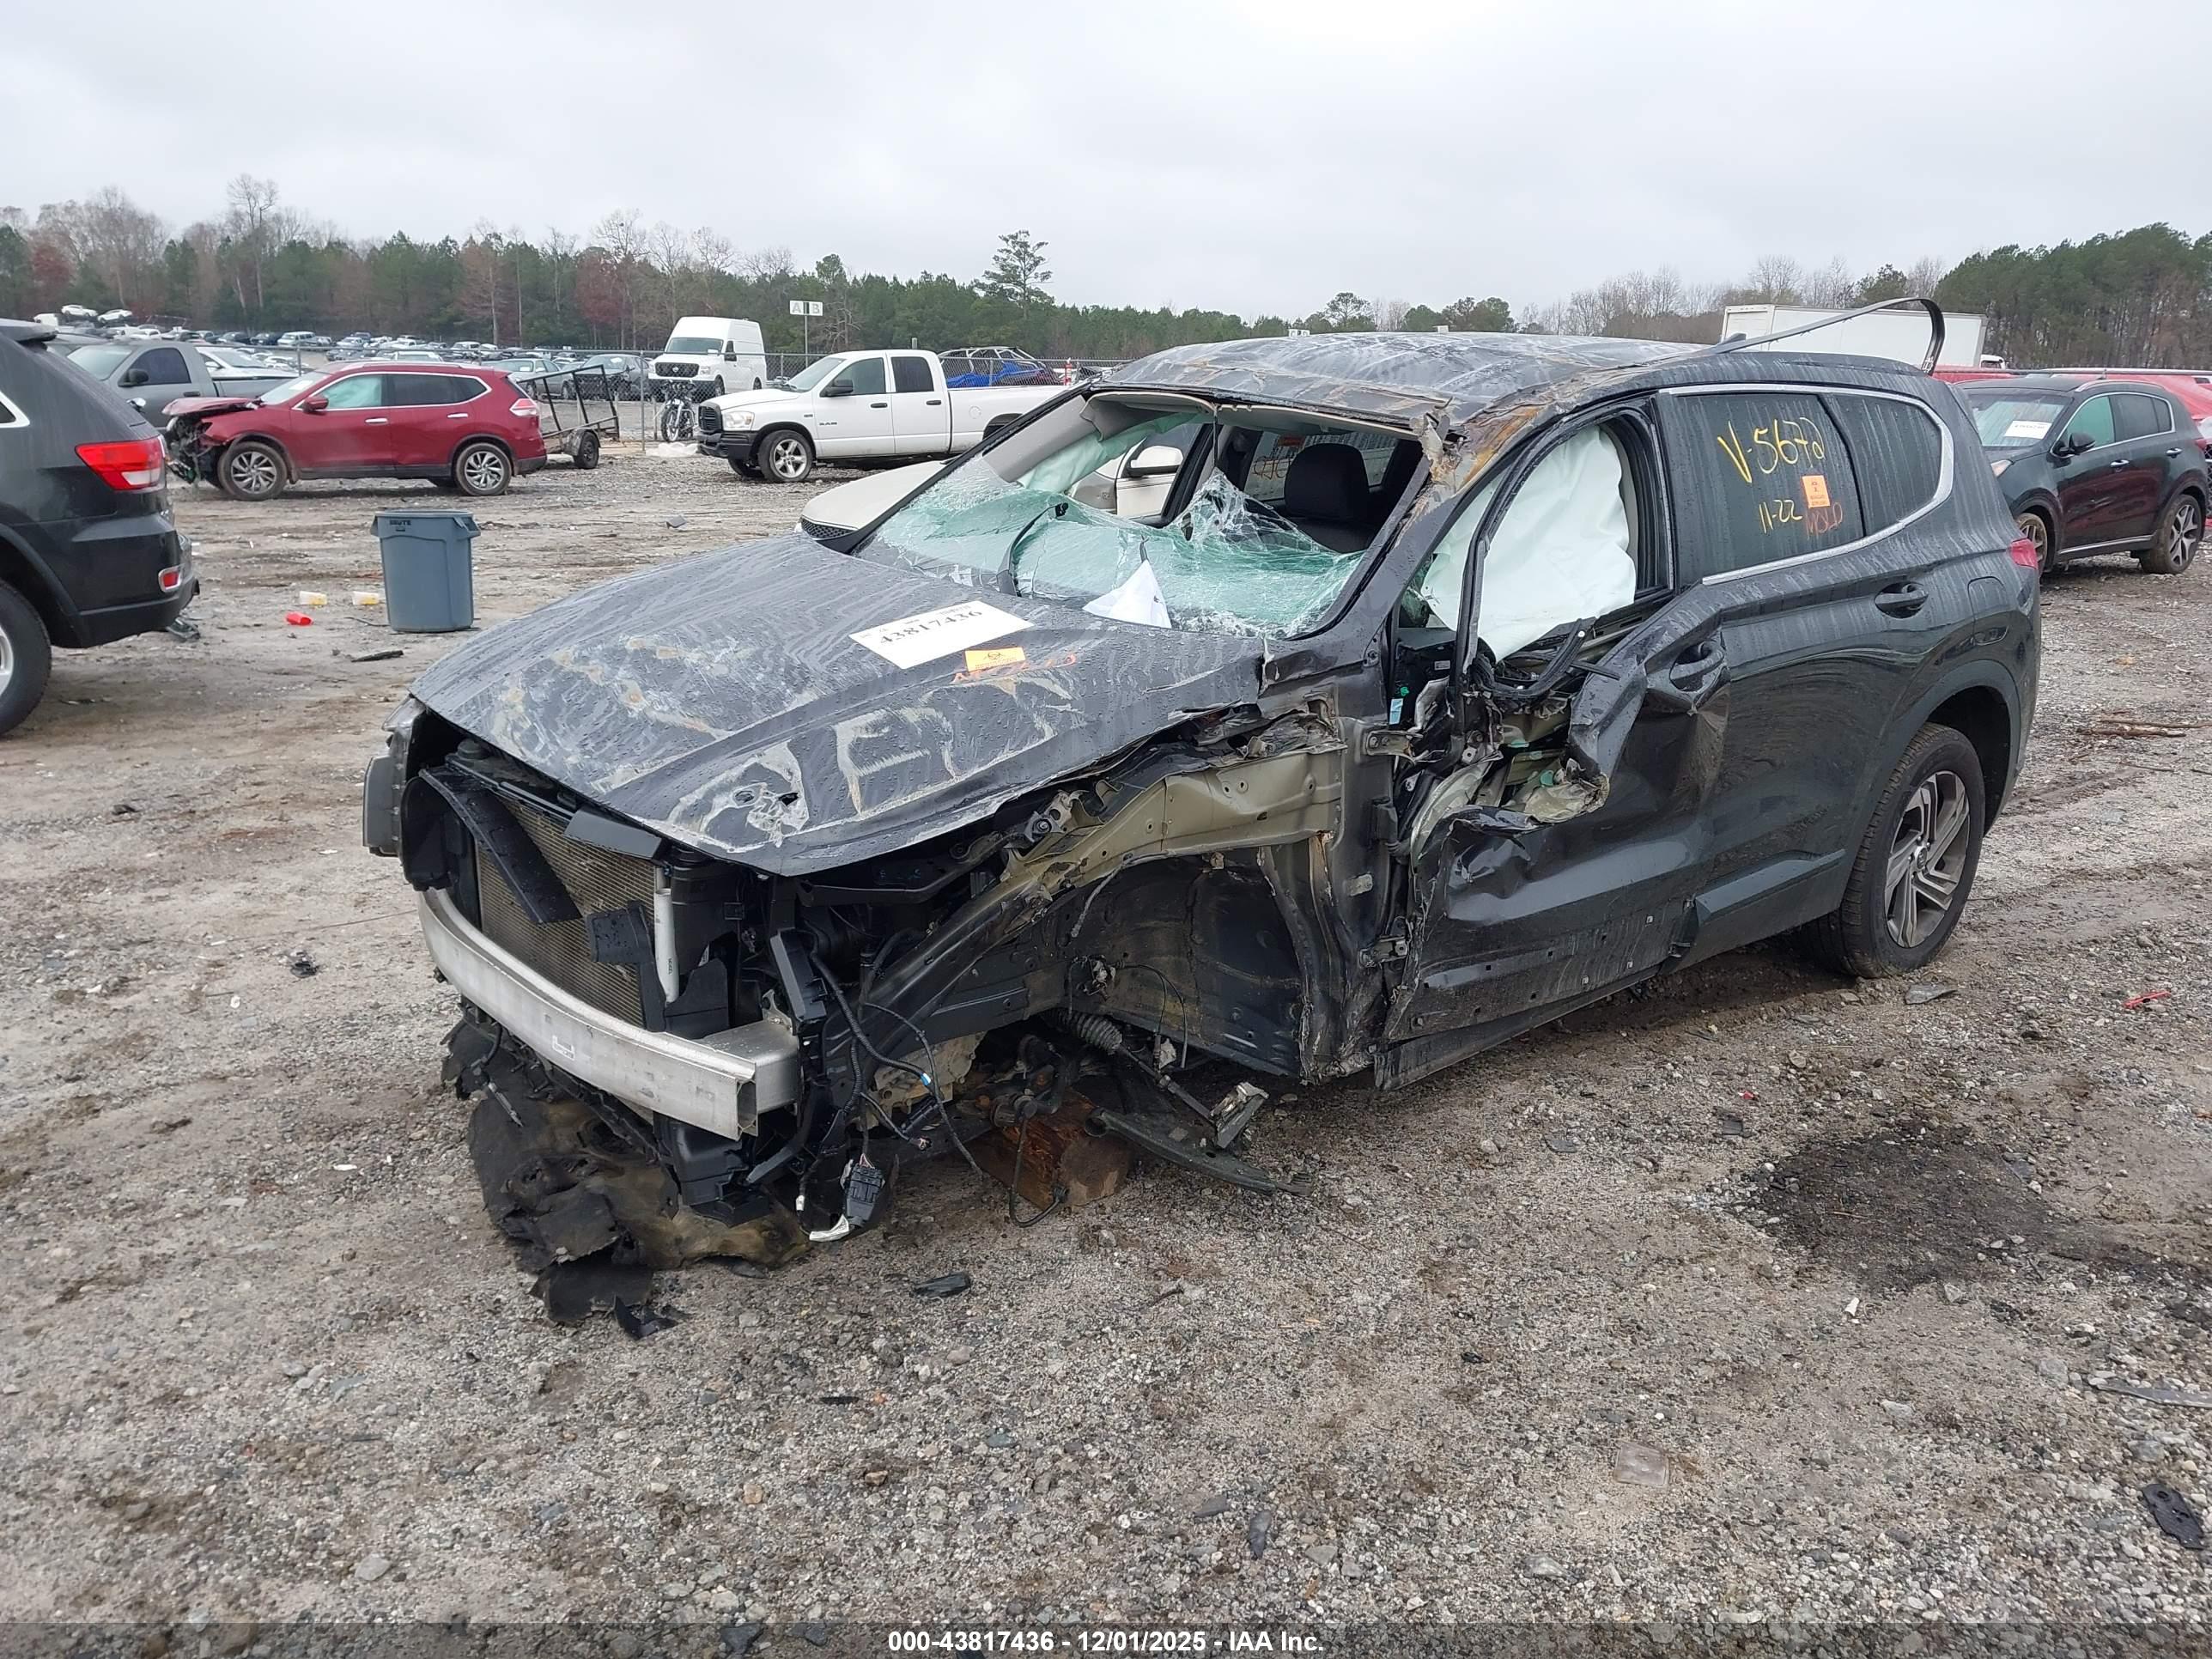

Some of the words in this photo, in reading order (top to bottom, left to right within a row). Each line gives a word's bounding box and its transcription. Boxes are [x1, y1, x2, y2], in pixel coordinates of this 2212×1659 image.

[792, 302, 802, 313] A
[811, 303, 820, 314] B
[1759, 499, 1803, 534] 11-22
[880, 610, 983, 644] 43817436
